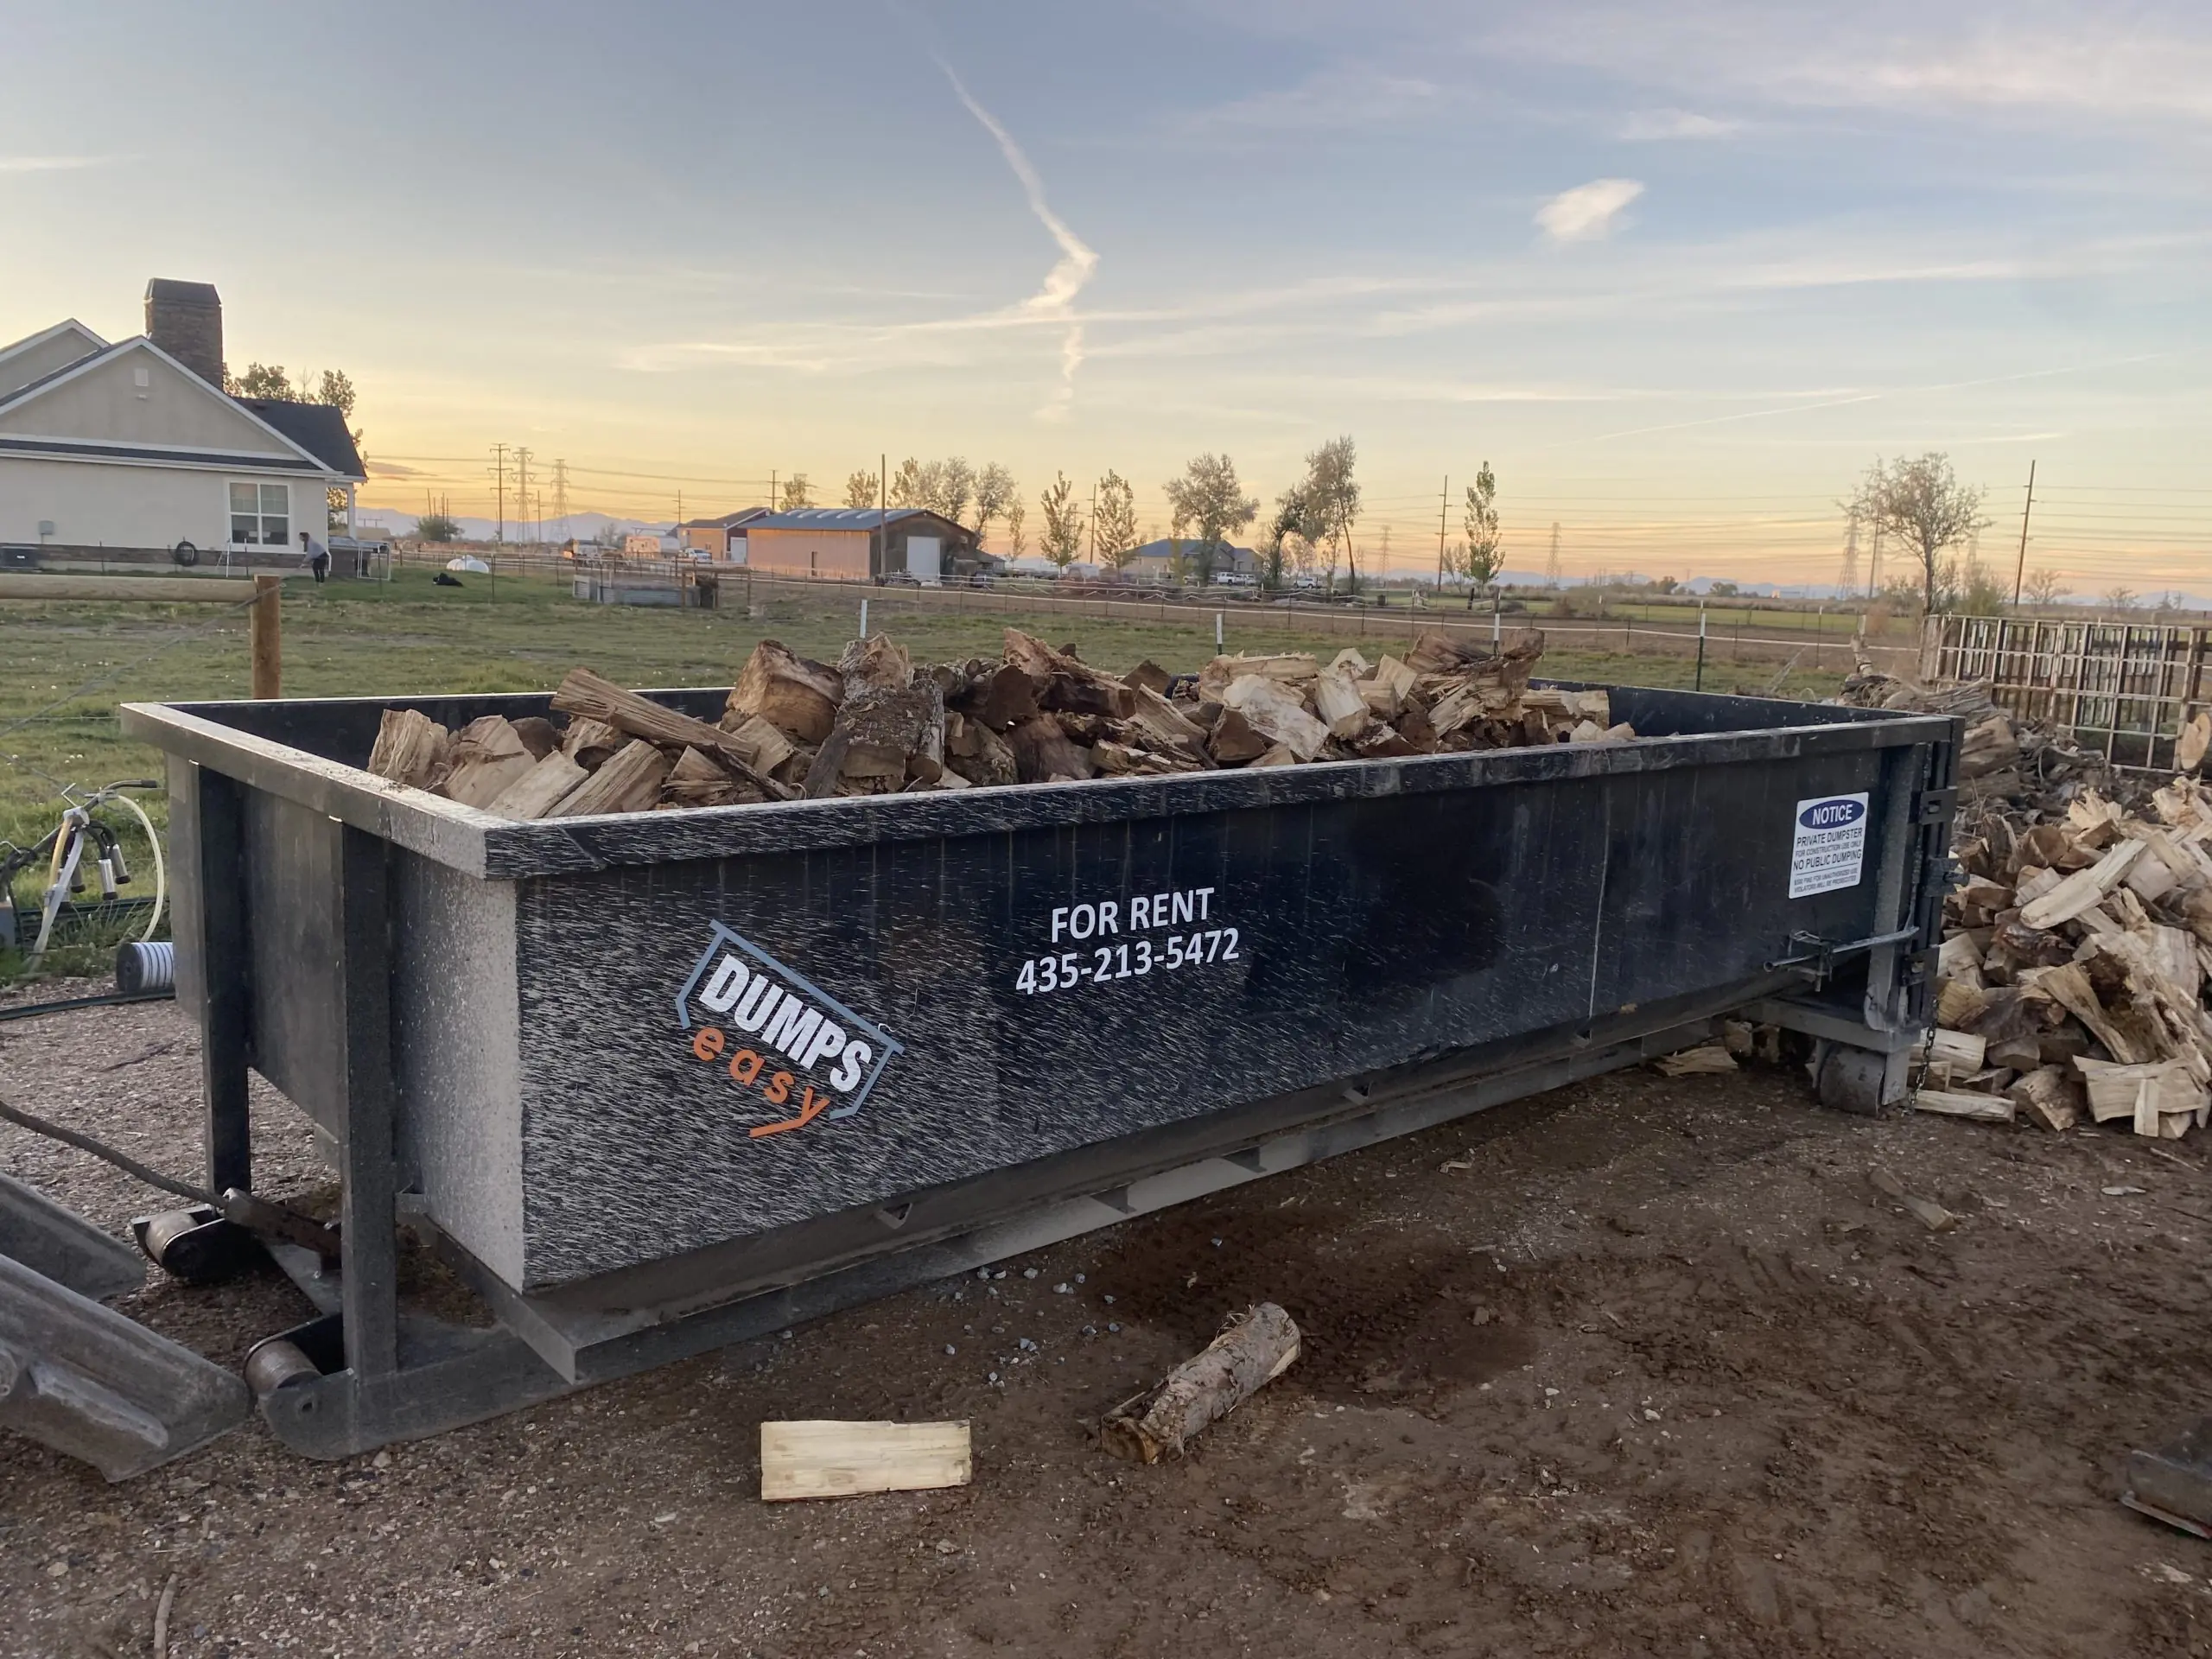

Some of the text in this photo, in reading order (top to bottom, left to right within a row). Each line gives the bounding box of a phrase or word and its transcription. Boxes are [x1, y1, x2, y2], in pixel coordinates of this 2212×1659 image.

[1812, 804, 1853, 826] NOTICE
[1795, 849, 1806, 858] FOR
[1806, 843, 1840, 856] CONSTRUCTION
[1796, 827, 1863, 848] PRIVATE DUMPSTER
[1793, 849, 1862, 871] NO PUBLIC DUMPING
[1051, 887, 1215, 943] FOR RENT
[1015, 927, 1240, 995] 435-213-5472
[698, 953, 873, 1092] DUMPS
[693, 1027, 830, 1139] easy
